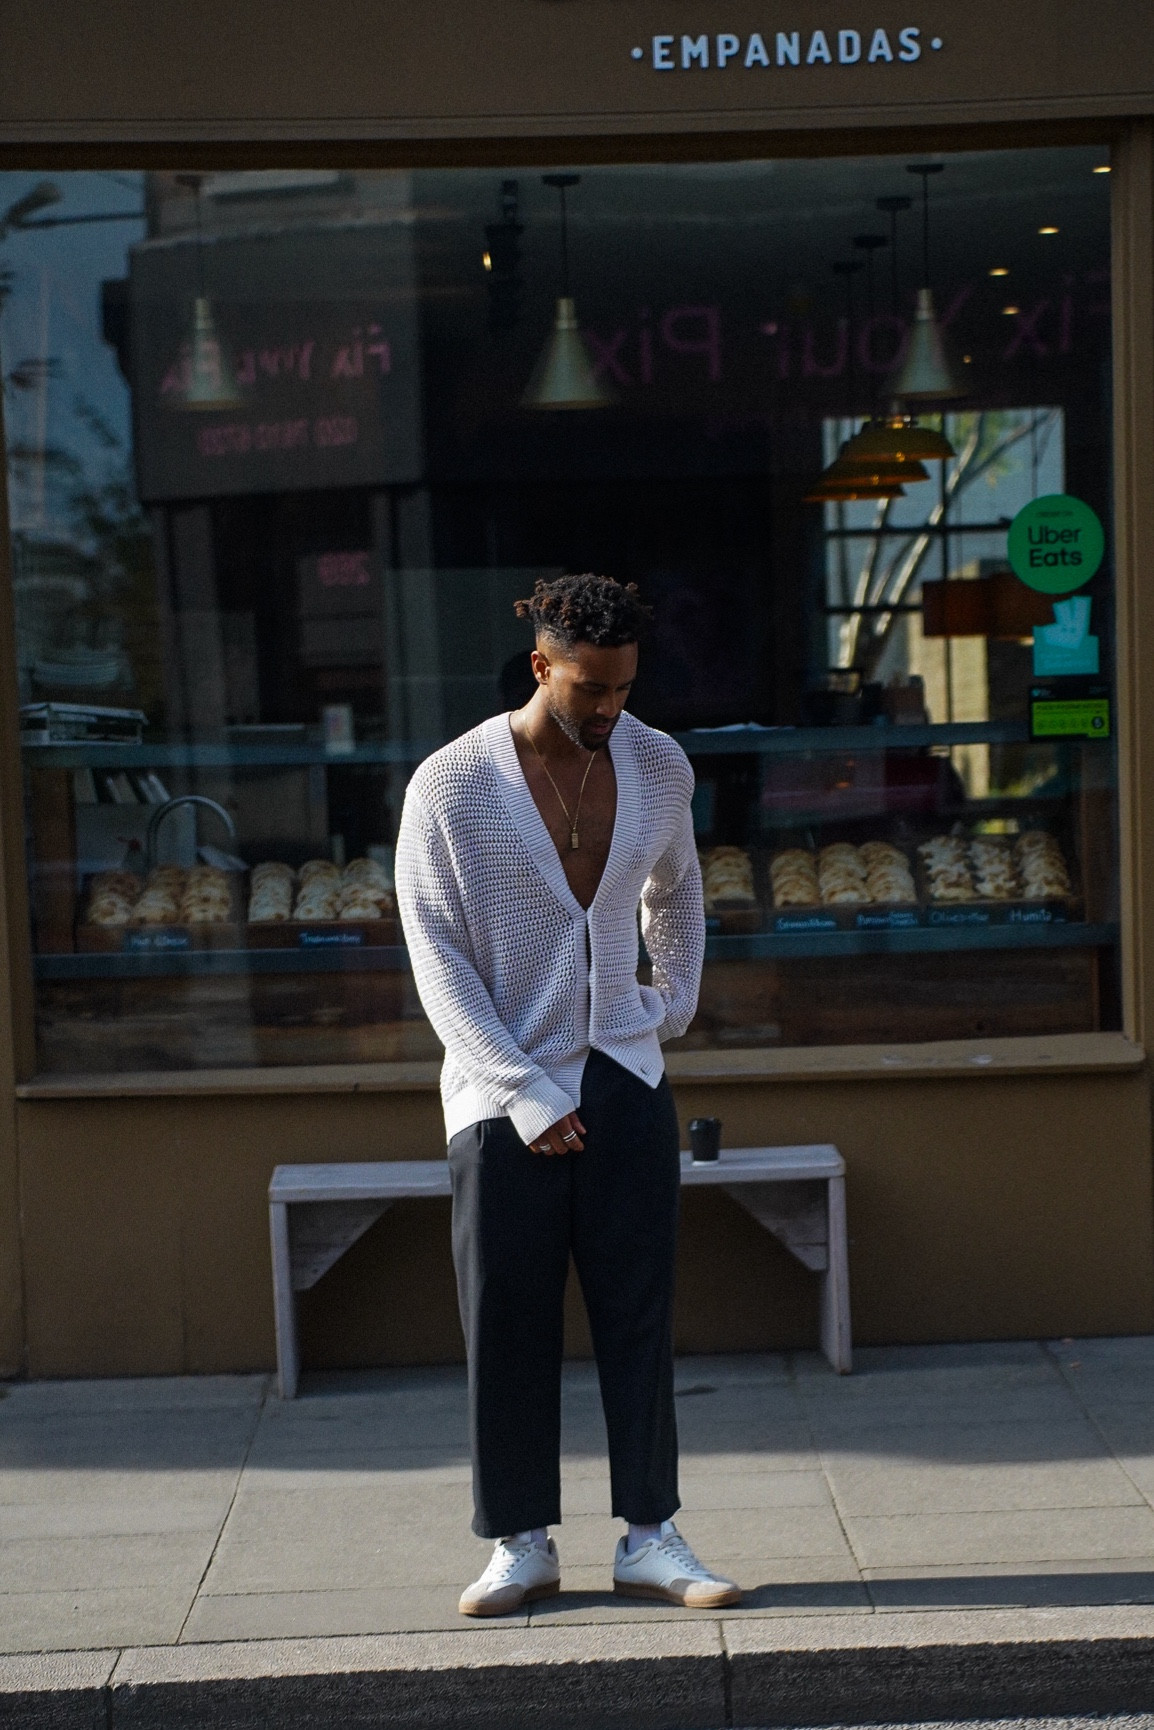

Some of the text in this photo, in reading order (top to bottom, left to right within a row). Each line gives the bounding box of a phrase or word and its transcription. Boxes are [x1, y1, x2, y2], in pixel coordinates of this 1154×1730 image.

[651, 27, 923, 70] EMPANADAS
[1028, 526, 1081, 545] Uber
[1030, 548, 1083, 568] Eats
